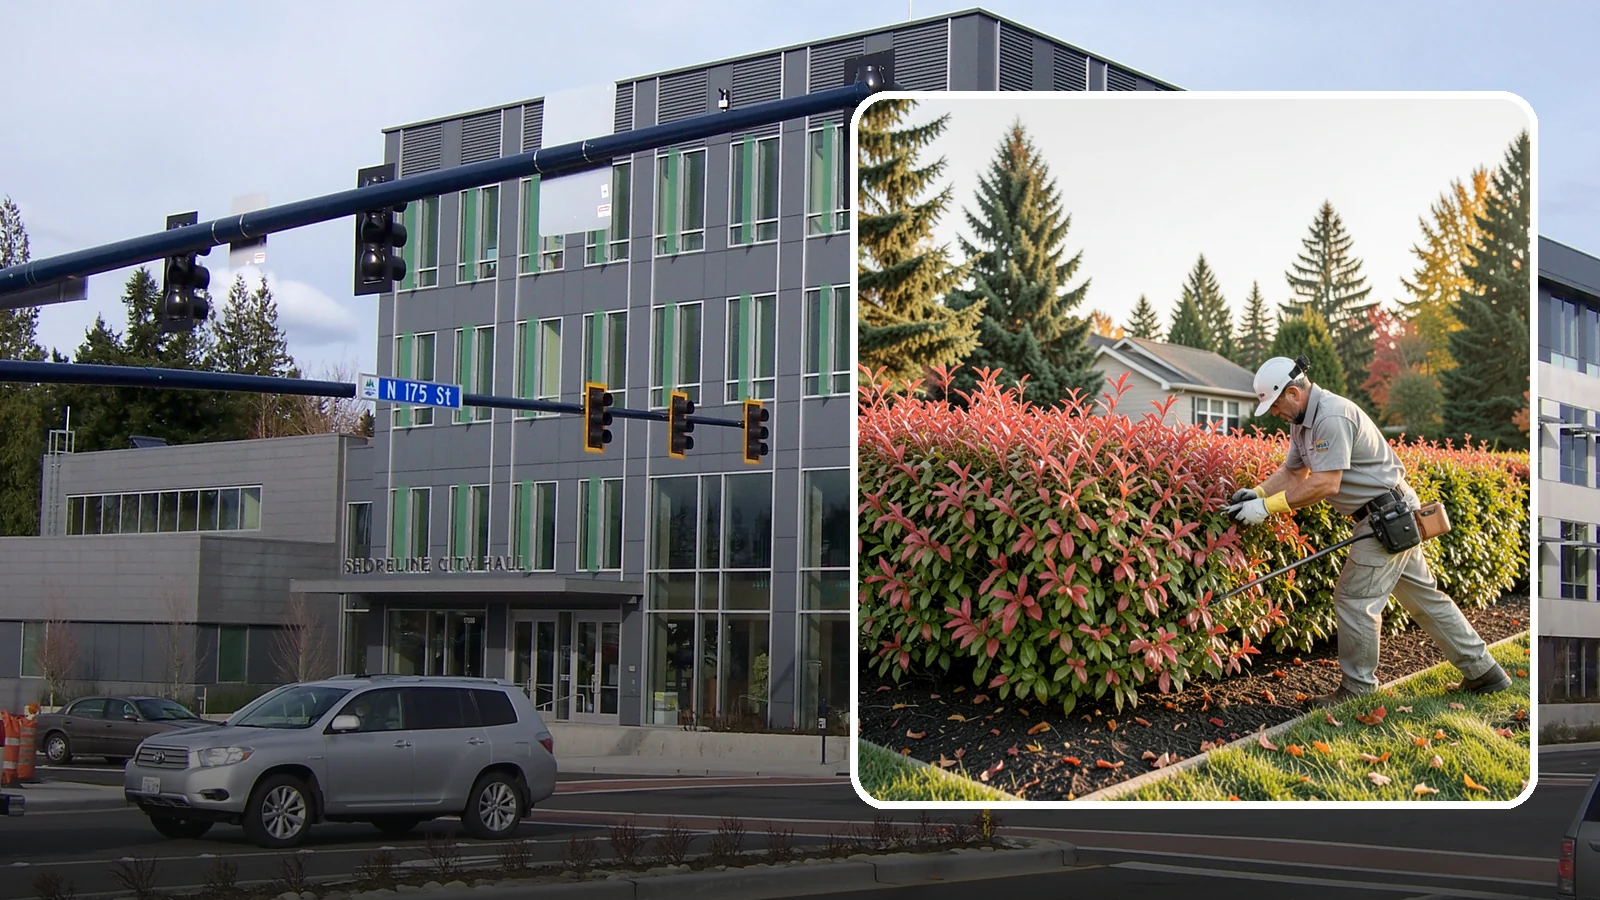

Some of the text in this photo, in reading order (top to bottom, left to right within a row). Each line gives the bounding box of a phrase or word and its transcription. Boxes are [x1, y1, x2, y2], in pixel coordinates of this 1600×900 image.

[387, 380, 451, 406] N 175 St
[344, 555, 526, 574] SHORELINE CITY HALL
